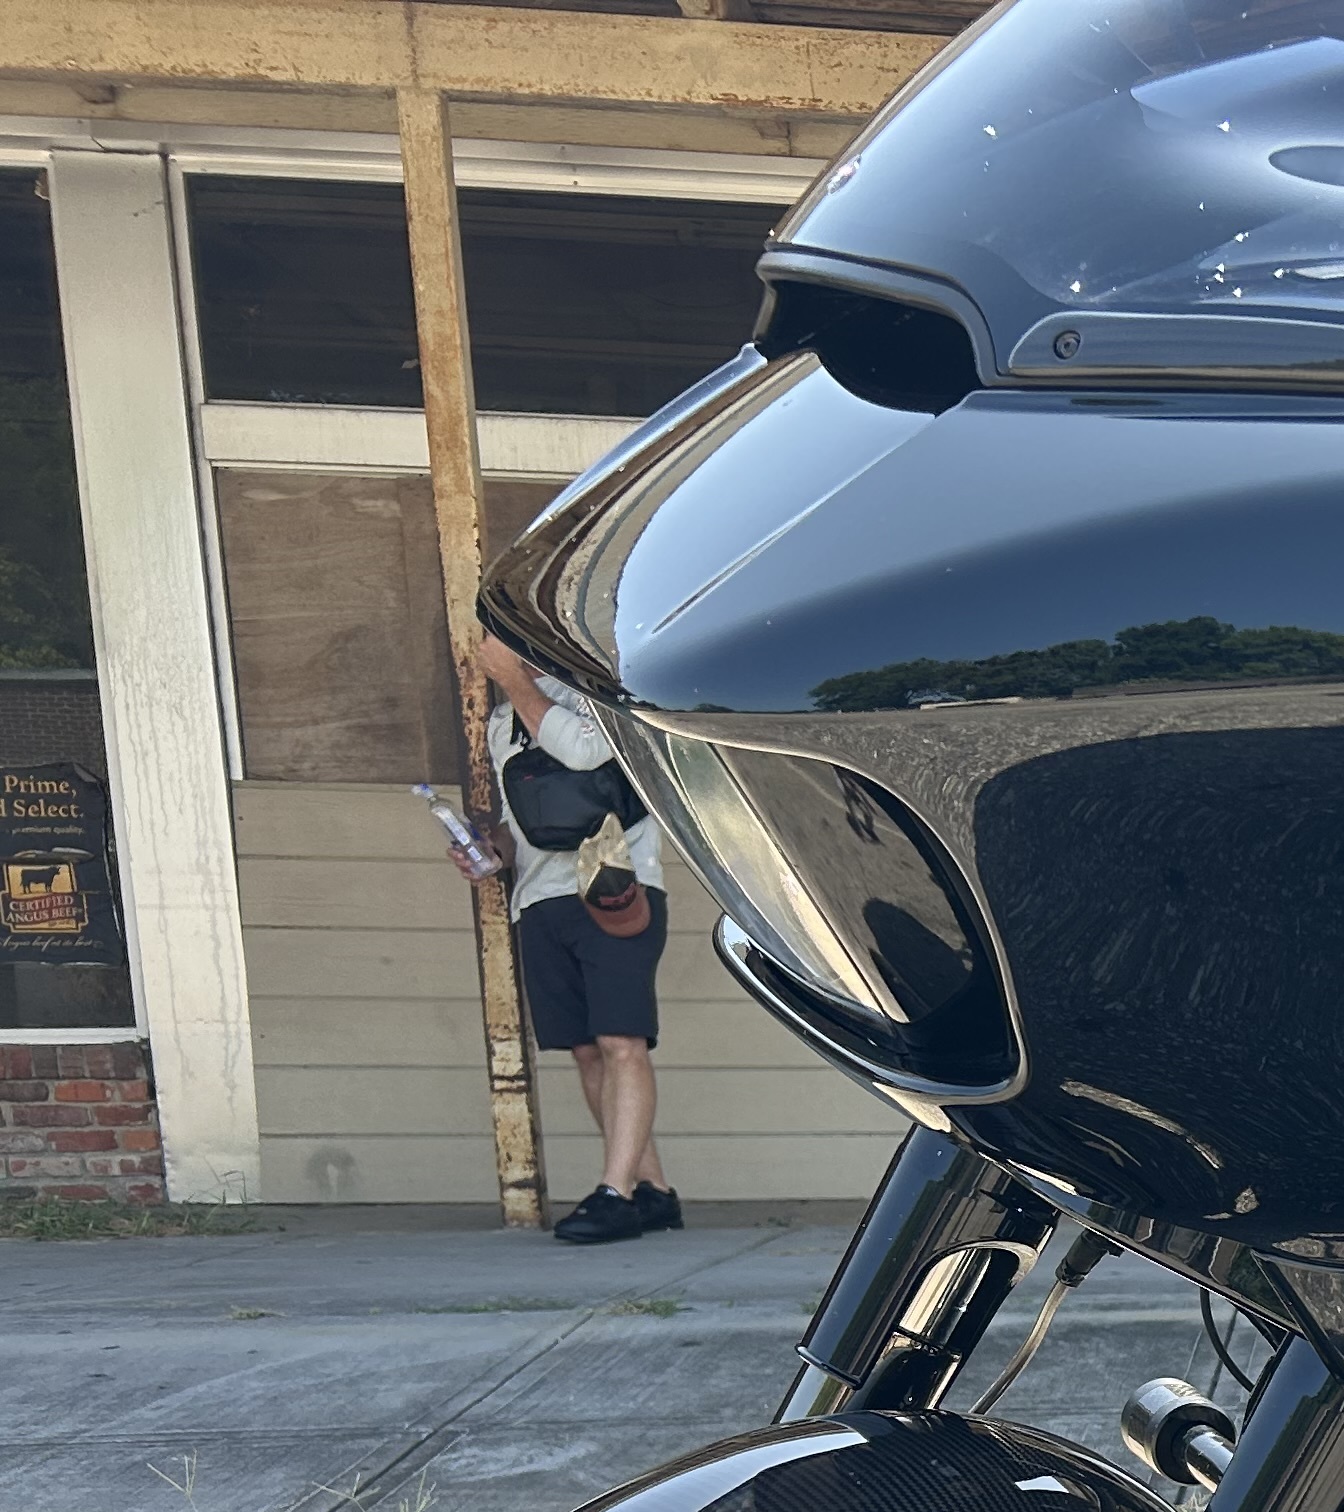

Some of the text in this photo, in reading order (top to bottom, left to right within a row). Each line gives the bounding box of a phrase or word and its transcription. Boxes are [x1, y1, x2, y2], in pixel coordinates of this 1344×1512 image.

[4, 774, 77, 799] Prime,
[13, 798, 84, 818] Select.
[9, 895, 74, 911] CERTIFIED
[6, 909, 49, 923] ANGUS
